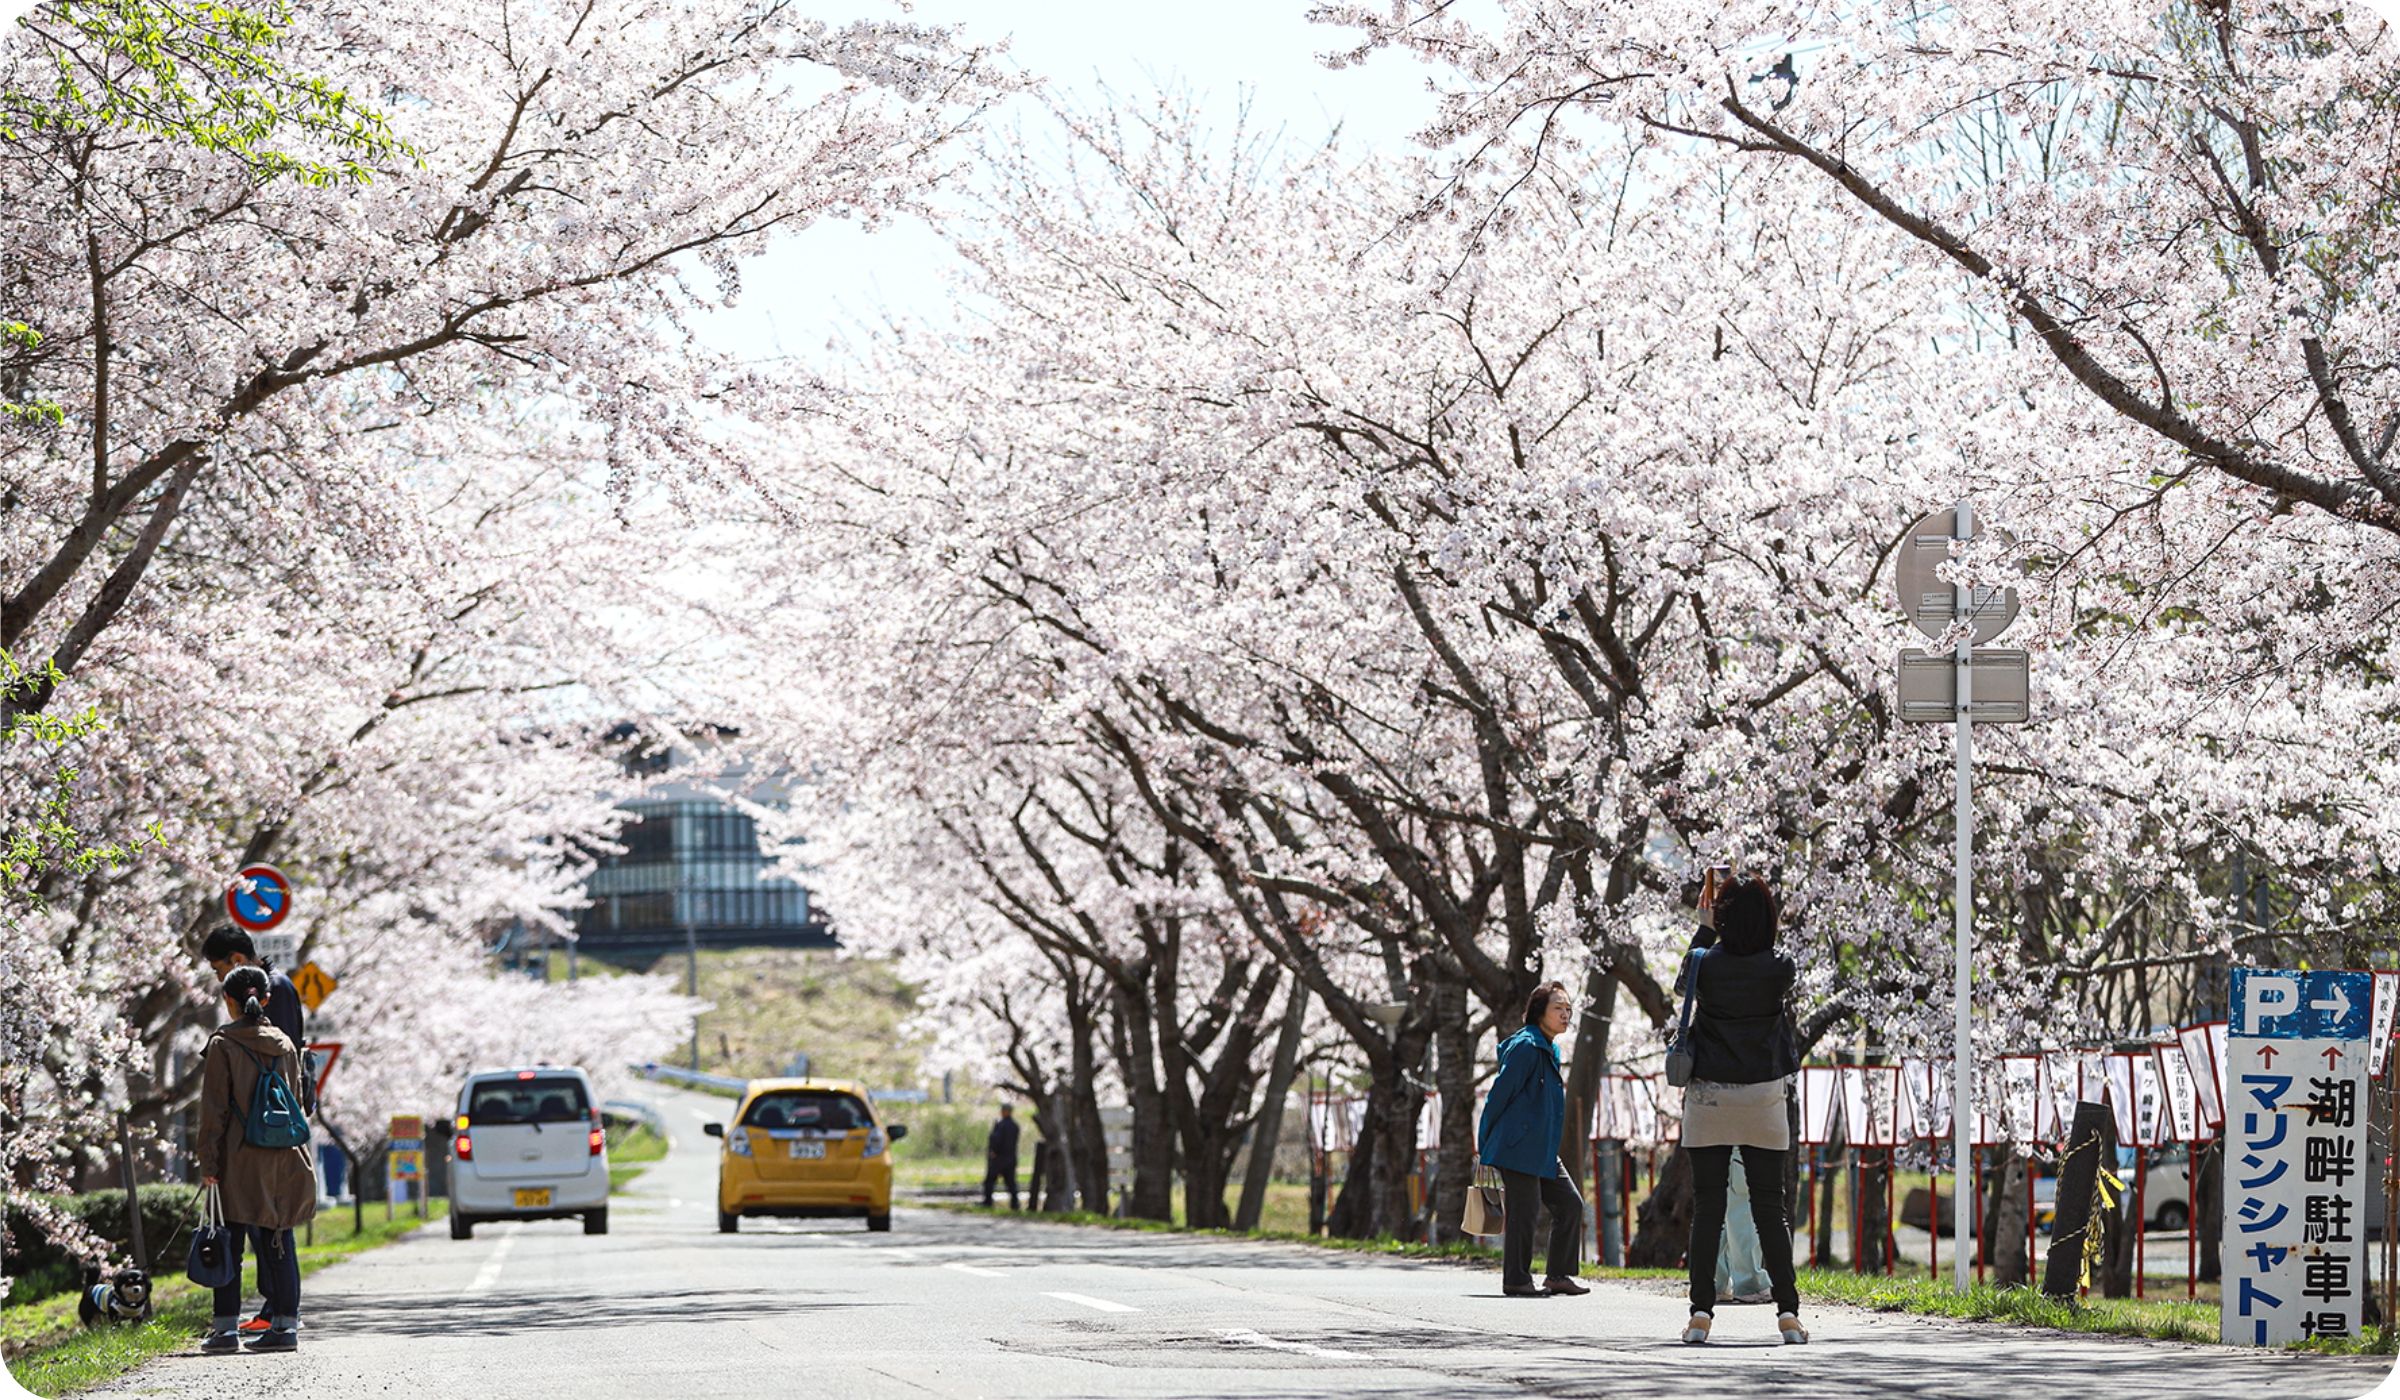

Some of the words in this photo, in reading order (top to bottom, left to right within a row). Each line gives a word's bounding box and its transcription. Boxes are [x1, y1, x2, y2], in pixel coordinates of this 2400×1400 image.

[2244, 976, 2299, 1034] P
[2239, 1074, 2293, 1346] マリンシャトー
